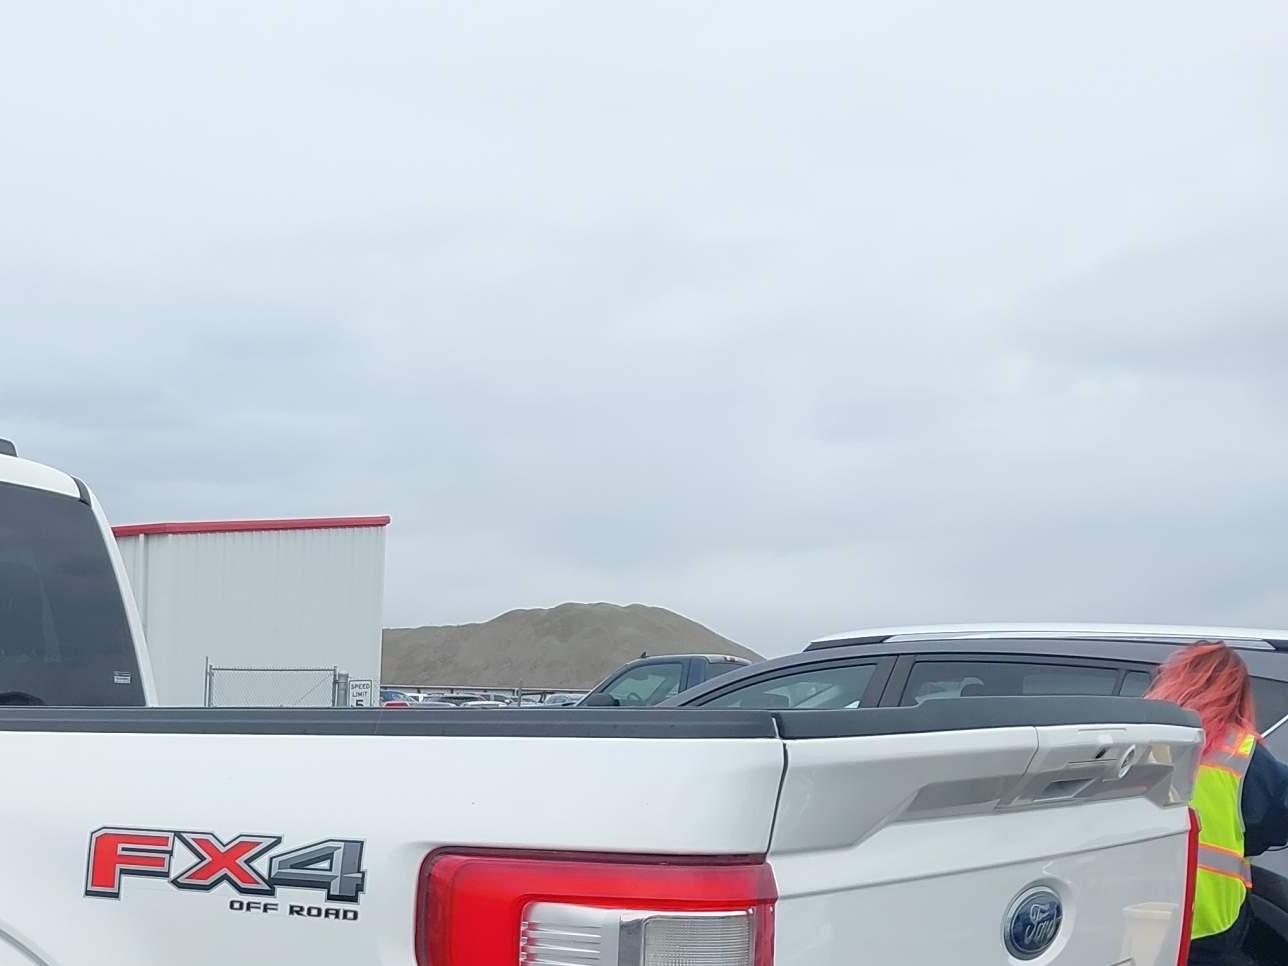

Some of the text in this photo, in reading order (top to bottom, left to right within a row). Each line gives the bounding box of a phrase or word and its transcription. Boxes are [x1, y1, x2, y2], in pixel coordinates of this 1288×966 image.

[84, 827, 366, 904] FX4
[229, 900, 359, 922] OFF ROAD
